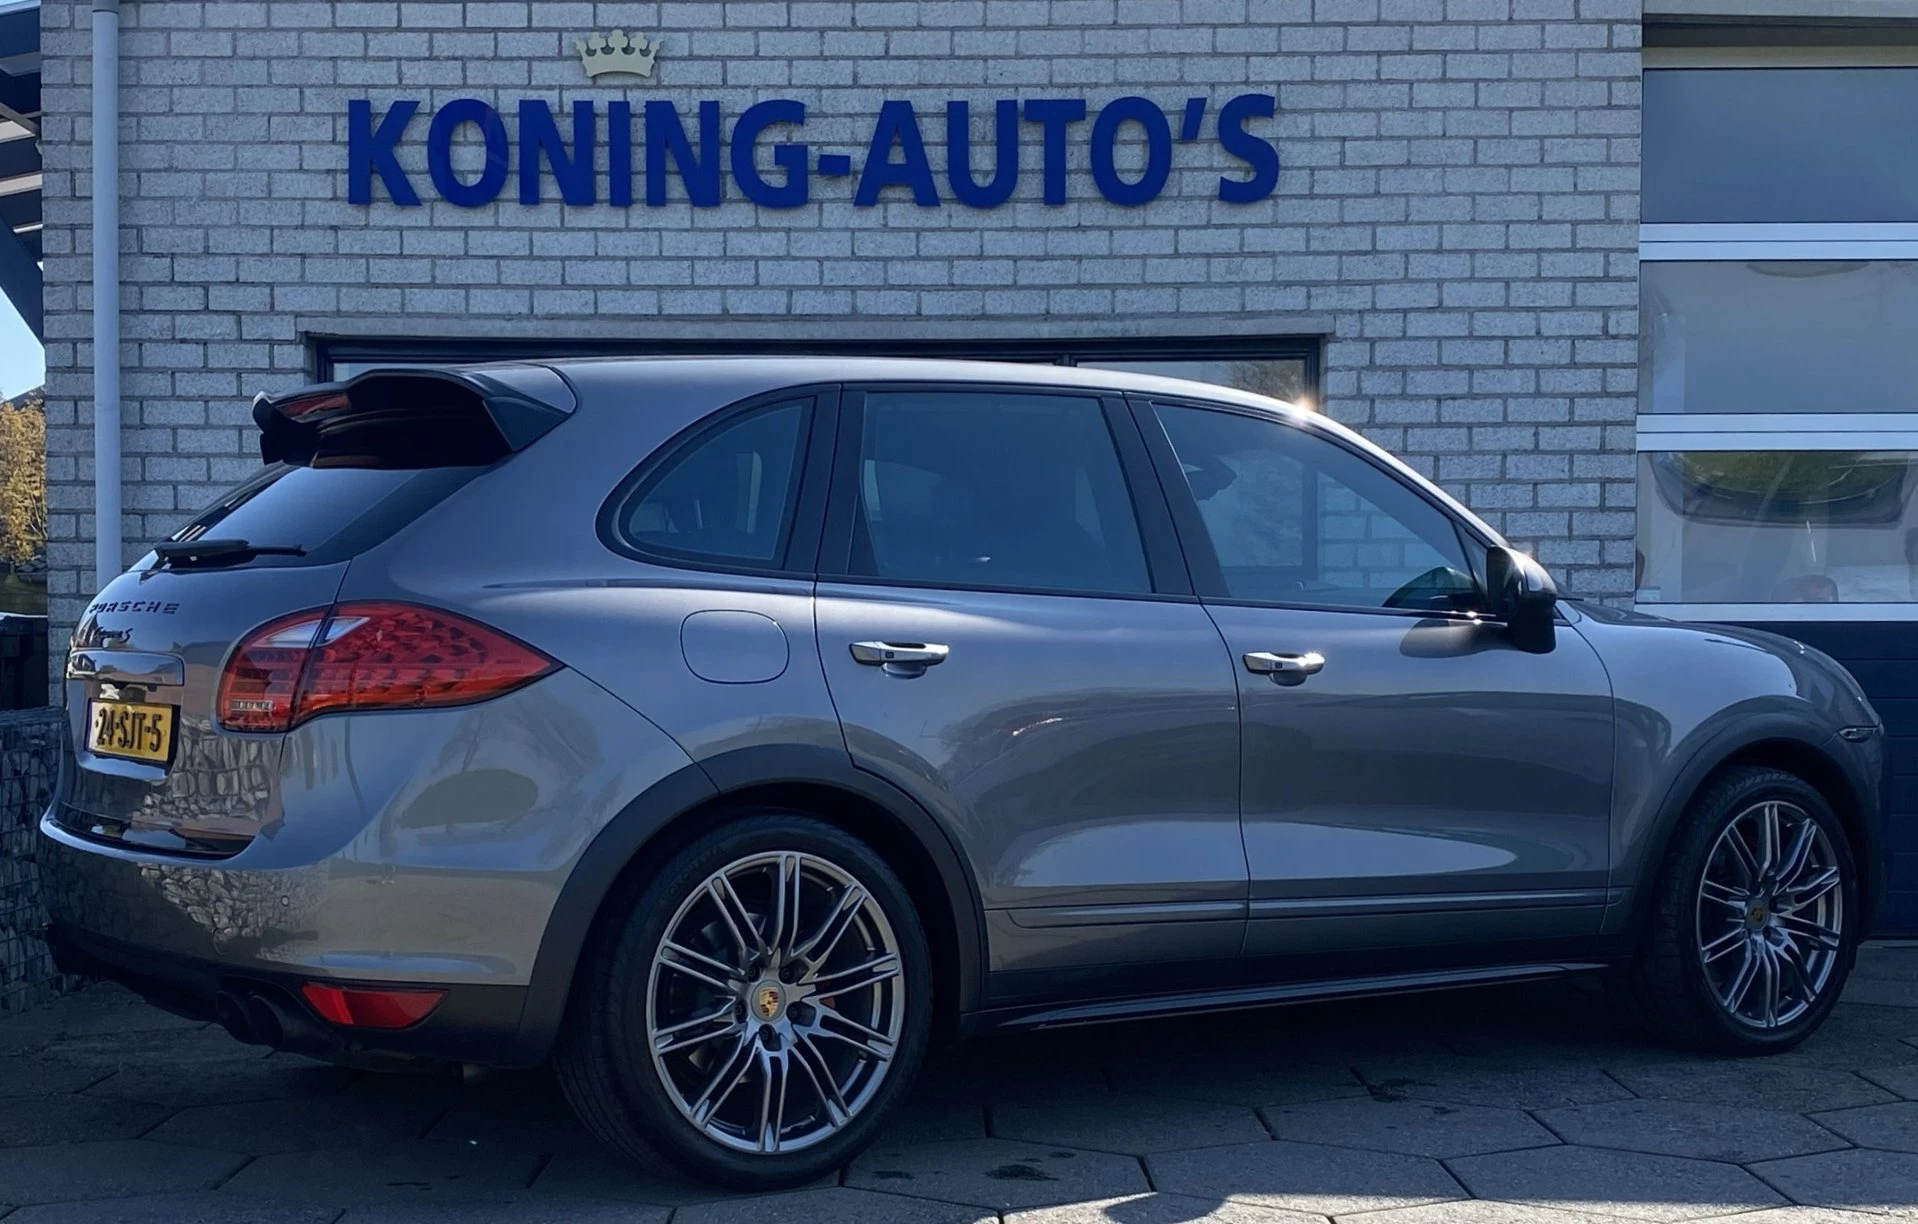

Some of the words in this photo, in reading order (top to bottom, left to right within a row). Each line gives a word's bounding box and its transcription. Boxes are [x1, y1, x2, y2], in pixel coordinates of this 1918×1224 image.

[347, 93, 1280, 209] KONING-AUTO'S
[90, 601, 180, 614] PORSCHE
[98, 708, 162, 752] 24-SJT-5
